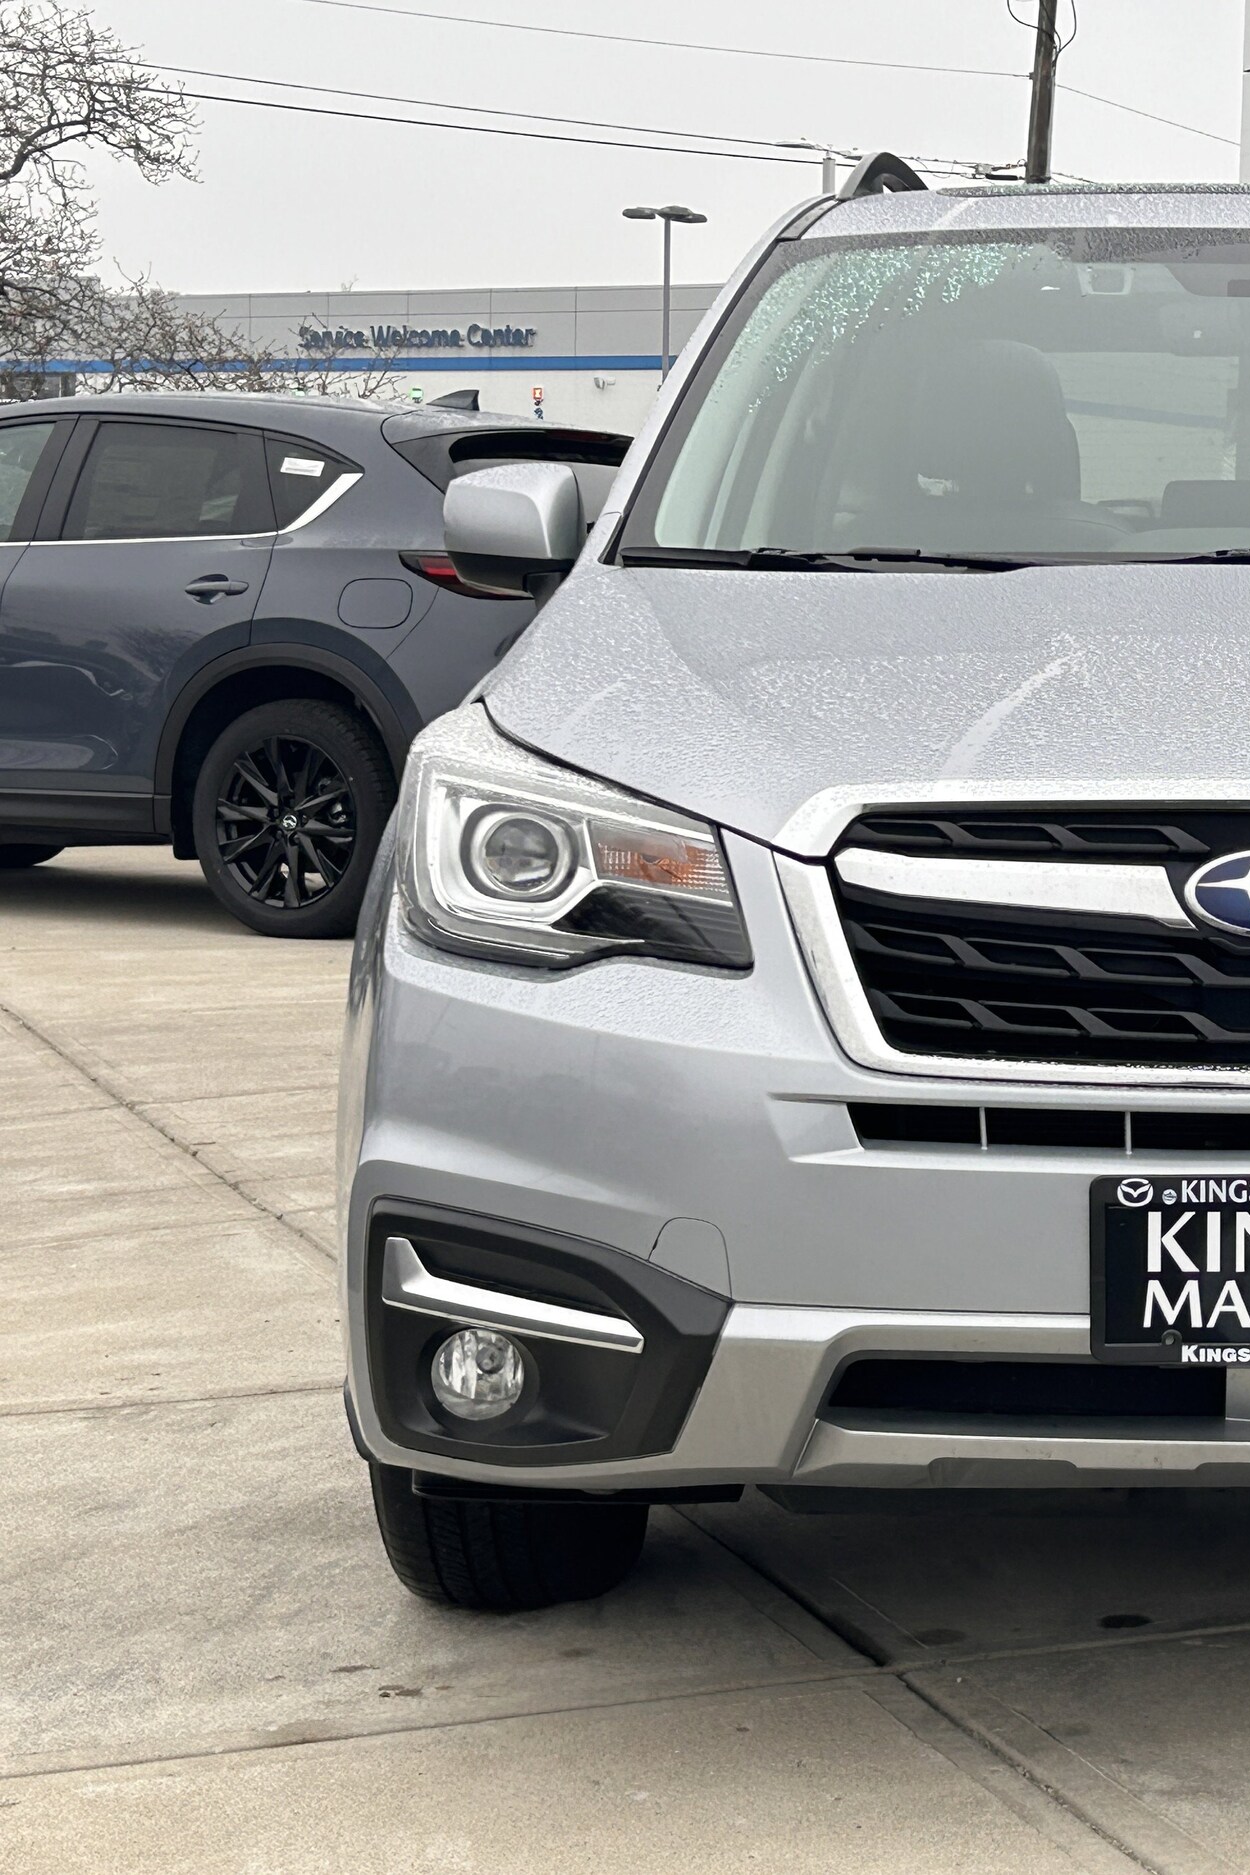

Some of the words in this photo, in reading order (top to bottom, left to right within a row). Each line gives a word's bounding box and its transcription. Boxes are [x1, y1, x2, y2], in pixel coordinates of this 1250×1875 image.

[298, 326, 367, 348] Service
[370, 325, 465, 348] Welcome
[467, 323, 535, 347] Center
